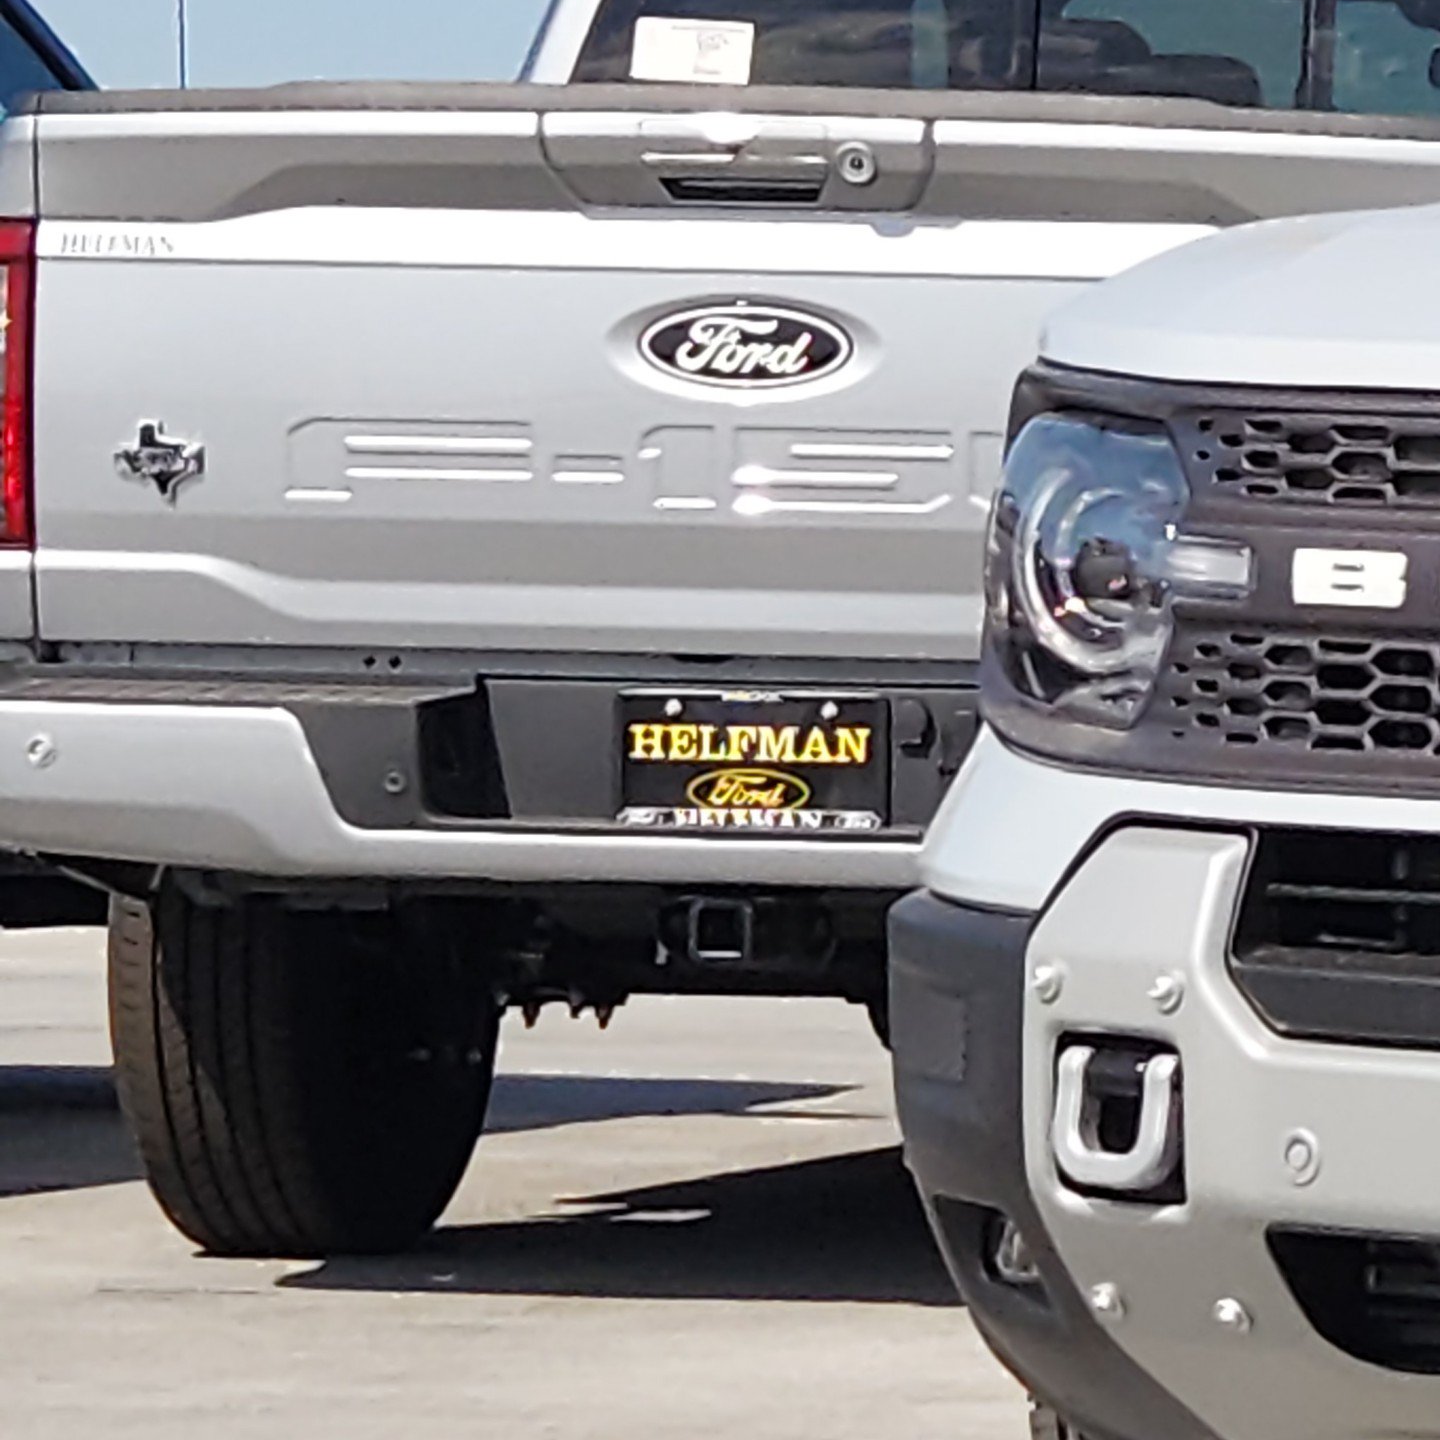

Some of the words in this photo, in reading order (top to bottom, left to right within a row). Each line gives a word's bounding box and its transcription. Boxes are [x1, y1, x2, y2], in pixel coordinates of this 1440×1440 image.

[675, 314, 814, 375] Ford
[627, 722, 872, 764] HELFMAN
[706, 774, 786, 808] Ford
